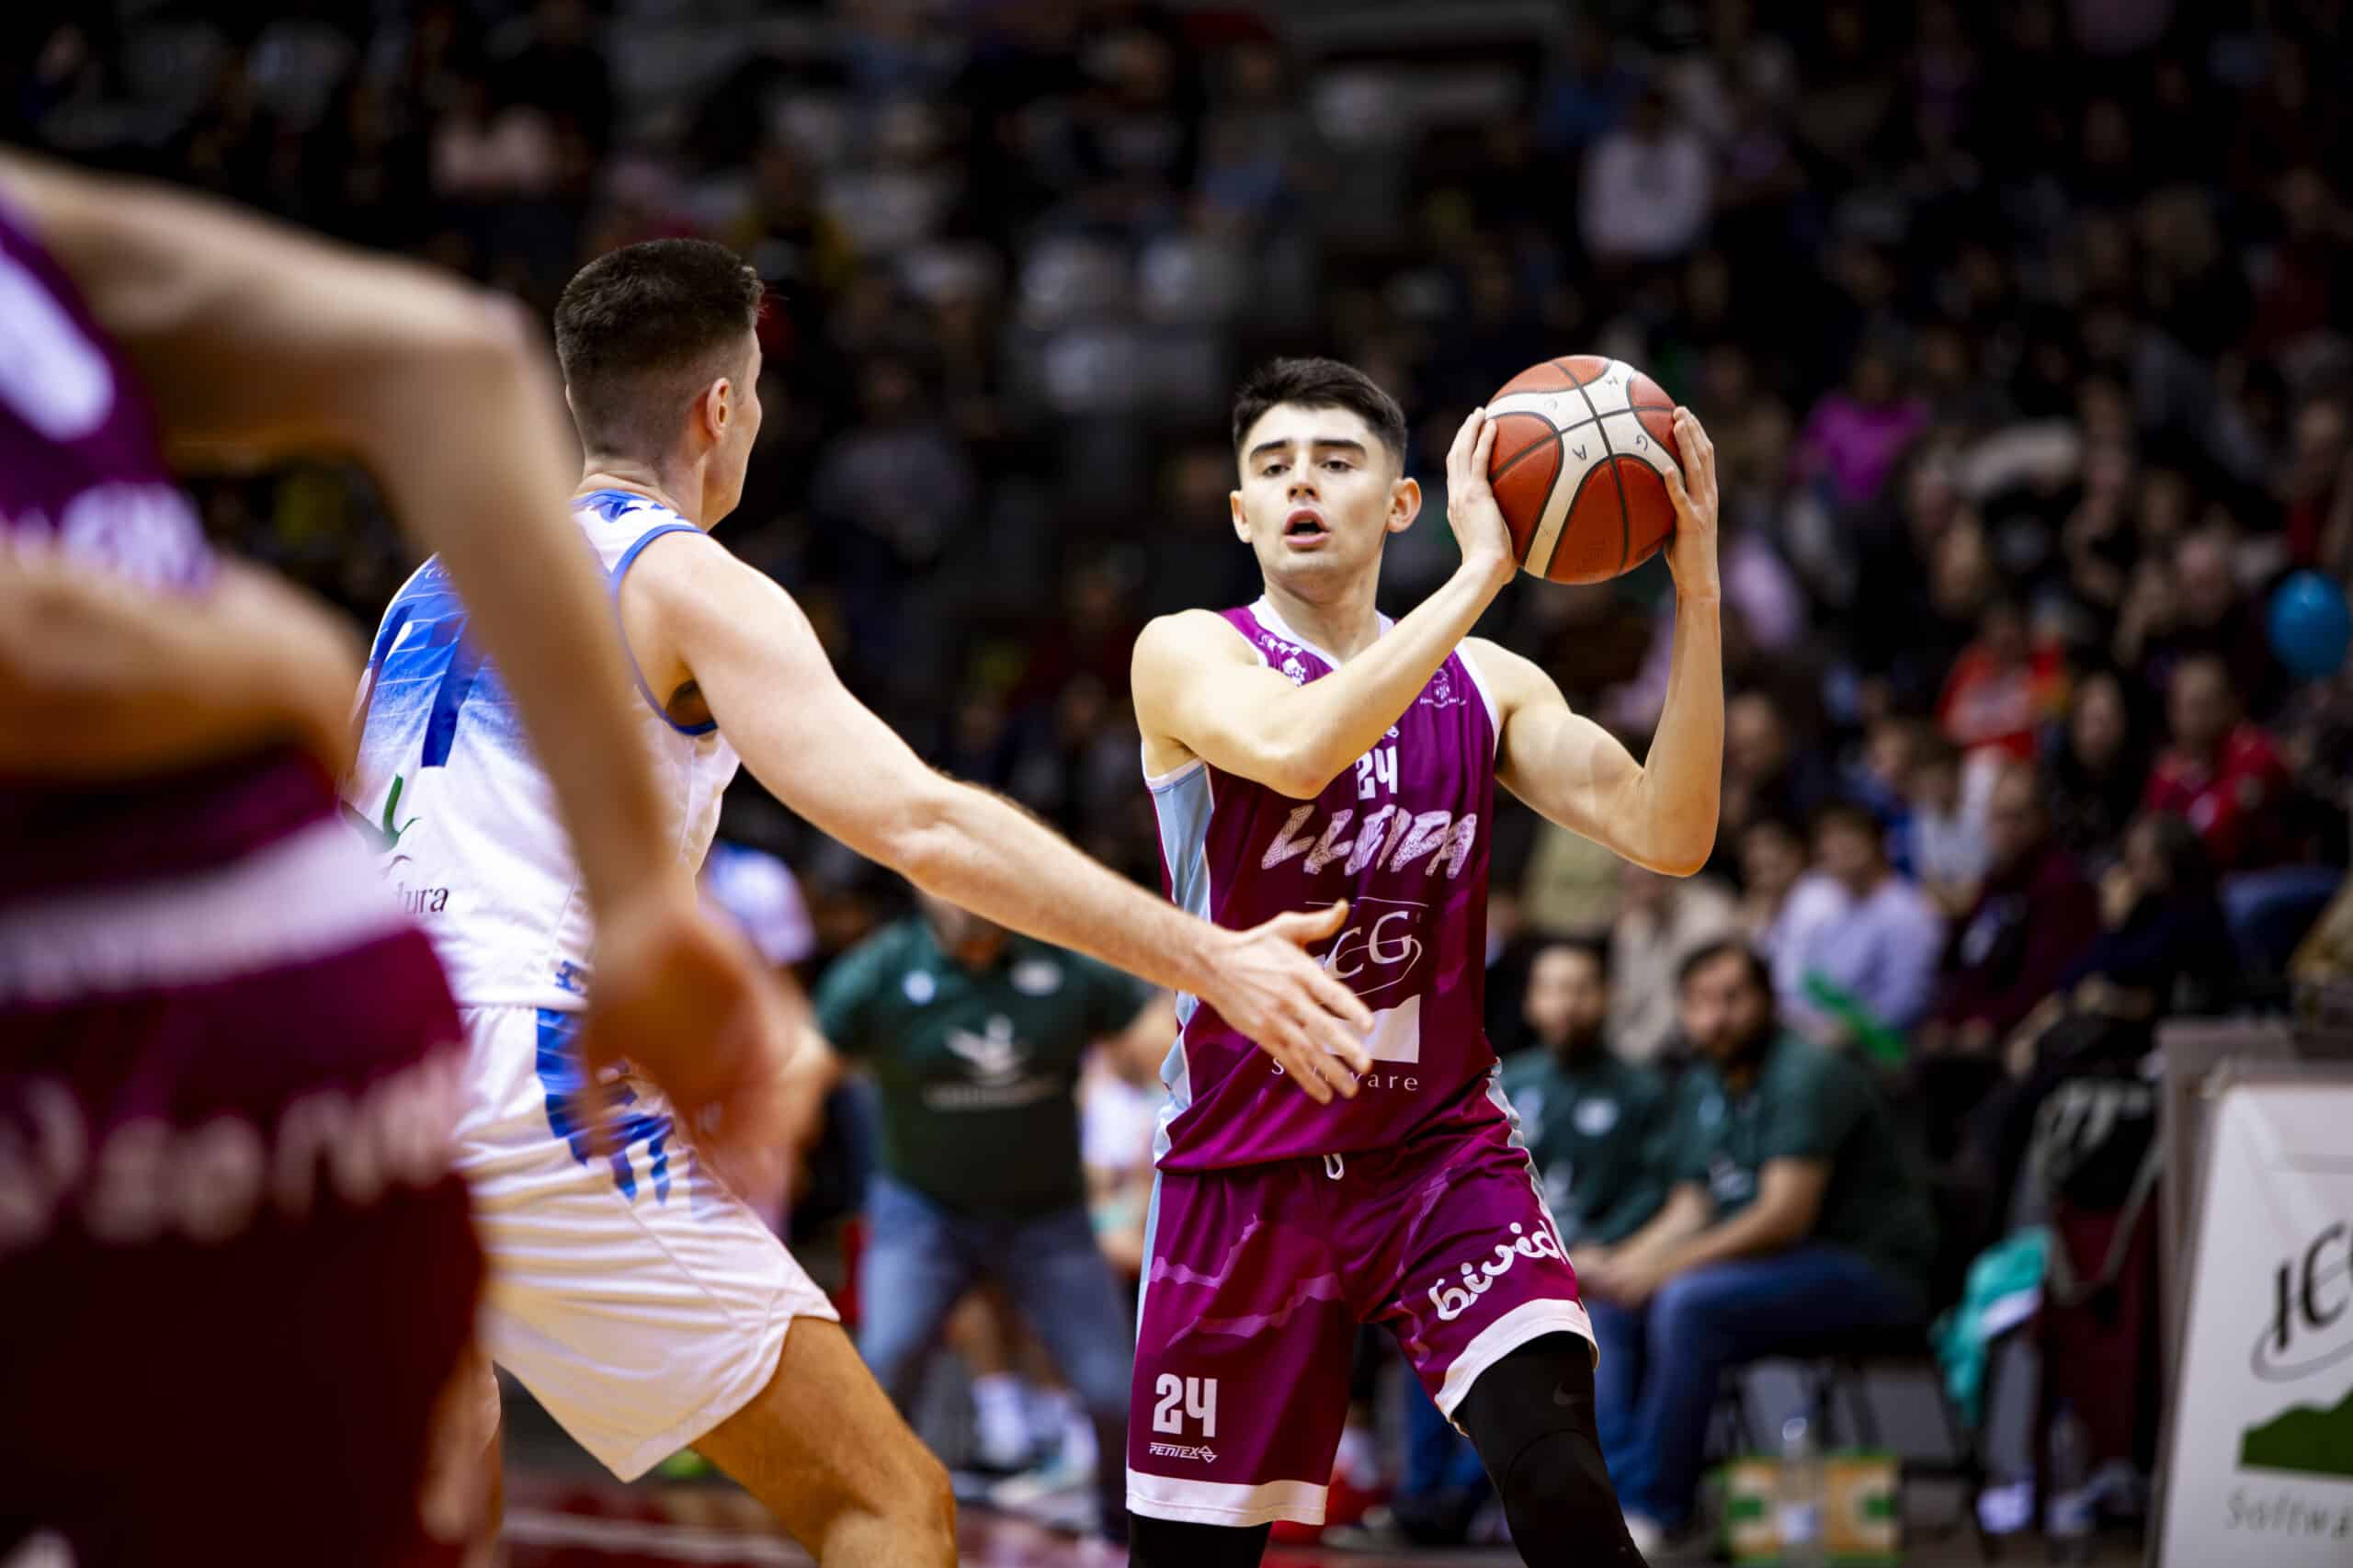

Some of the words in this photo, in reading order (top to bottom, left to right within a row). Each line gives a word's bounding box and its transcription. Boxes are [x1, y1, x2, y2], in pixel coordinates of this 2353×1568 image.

[1356, 745, 1398, 801] 24
[1313, 910, 1413, 980] CG
[2271, 1221, 2353, 1354] IC
[1152, 1372, 1219, 1438] 24
